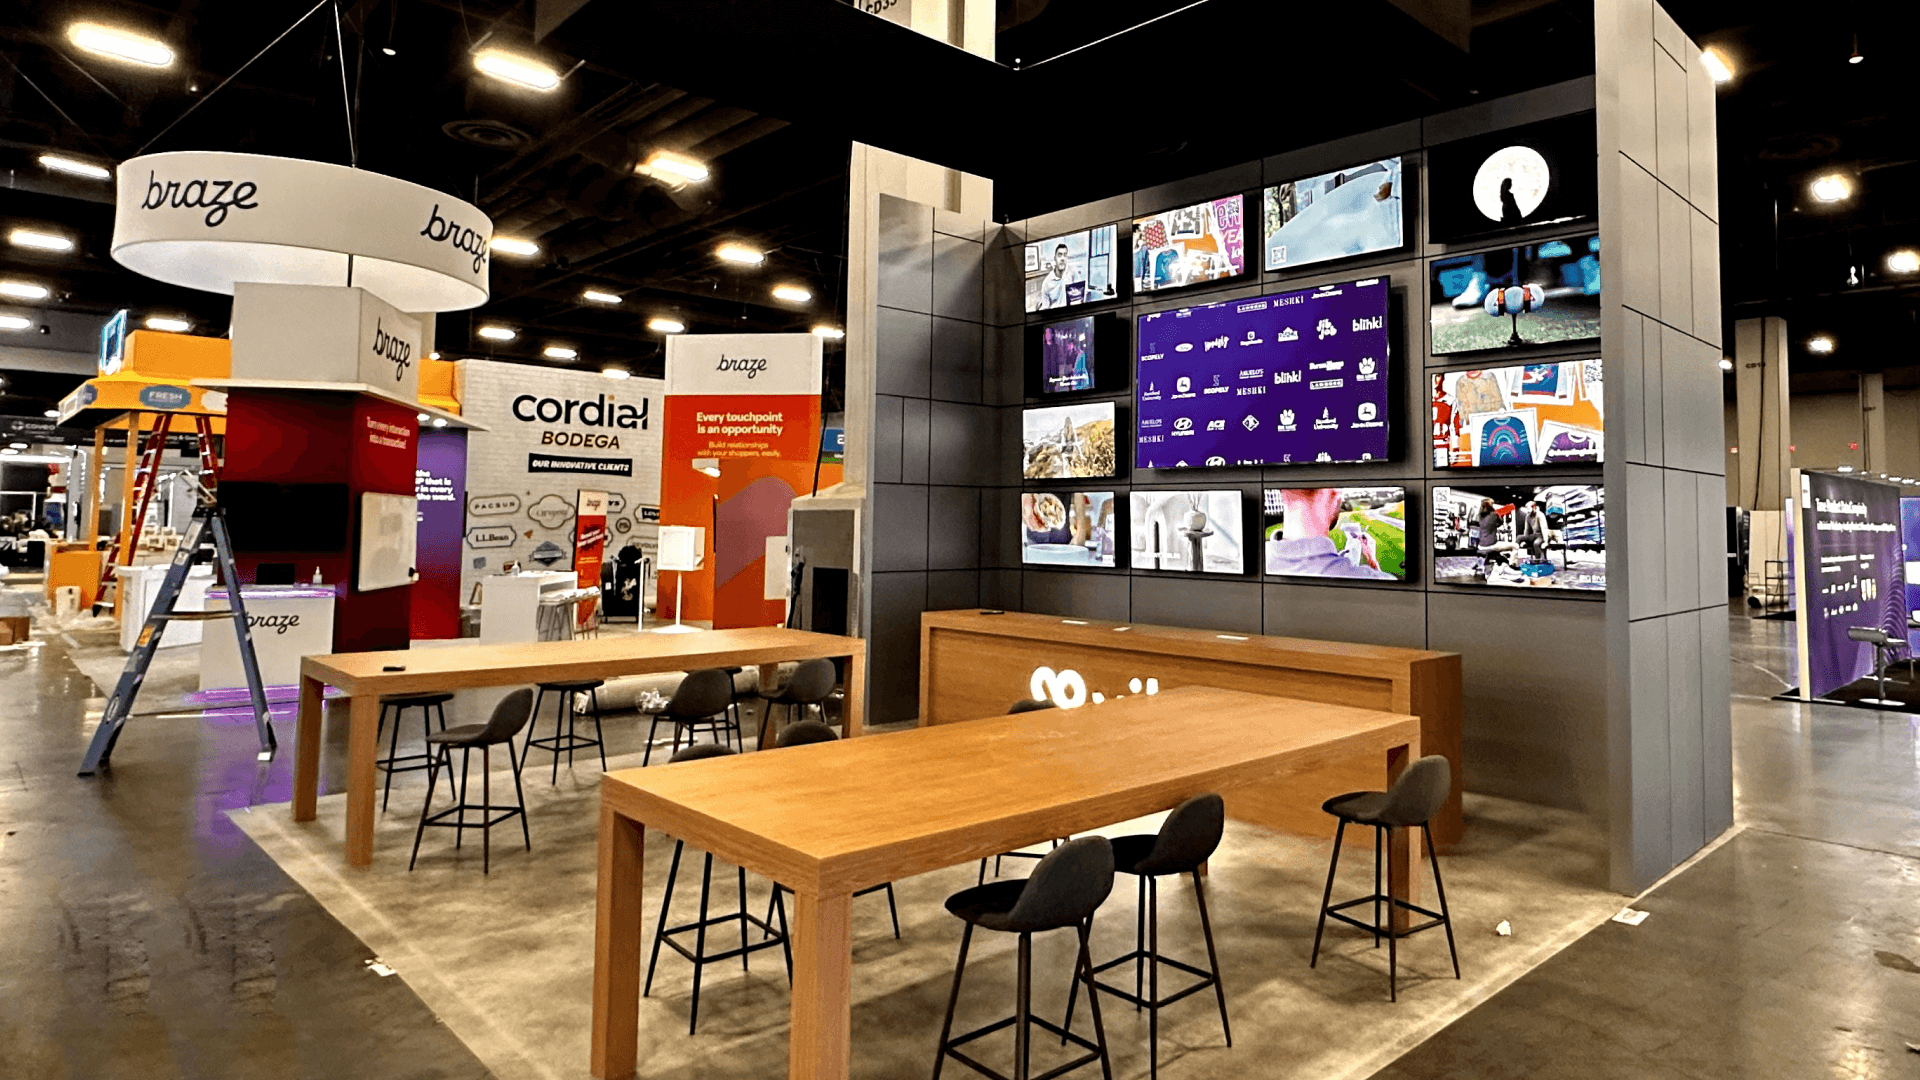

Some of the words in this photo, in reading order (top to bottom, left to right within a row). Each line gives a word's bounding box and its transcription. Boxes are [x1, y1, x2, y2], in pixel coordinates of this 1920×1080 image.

[141, 169, 259, 228] braze
[1273, 295, 1304, 308] MESHKI
[373, 317, 411, 382] braze
[716, 354, 767, 379] braze
[1236, 385, 1267, 396] MESHKI
[696, 412, 725, 424] Every
[726, 411, 783, 424] touchpoint
[697, 424, 706, 434] is
[707, 425, 720, 434] an
[721, 424, 783, 436] opportunity
[541, 431, 620, 449] BODEGA
[1139, 435, 1165, 443] MESHKI
[708, 441, 726, 449] Build
[727, 441, 769, 450] relationships
[532, 459, 549, 468] OUR
[550, 460, 597, 470] INNOVATIVE
[598, 463, 630, 472] CLIENTS
[425, 477, 443, 486] that
[444, 477, 452, 486] is
[420, 485, 429, 493] in
[429, 486, 453, 495] every
[474, 501, 515, 510] PACSUN
[475, 533, 509, 542] L.L.Bean
